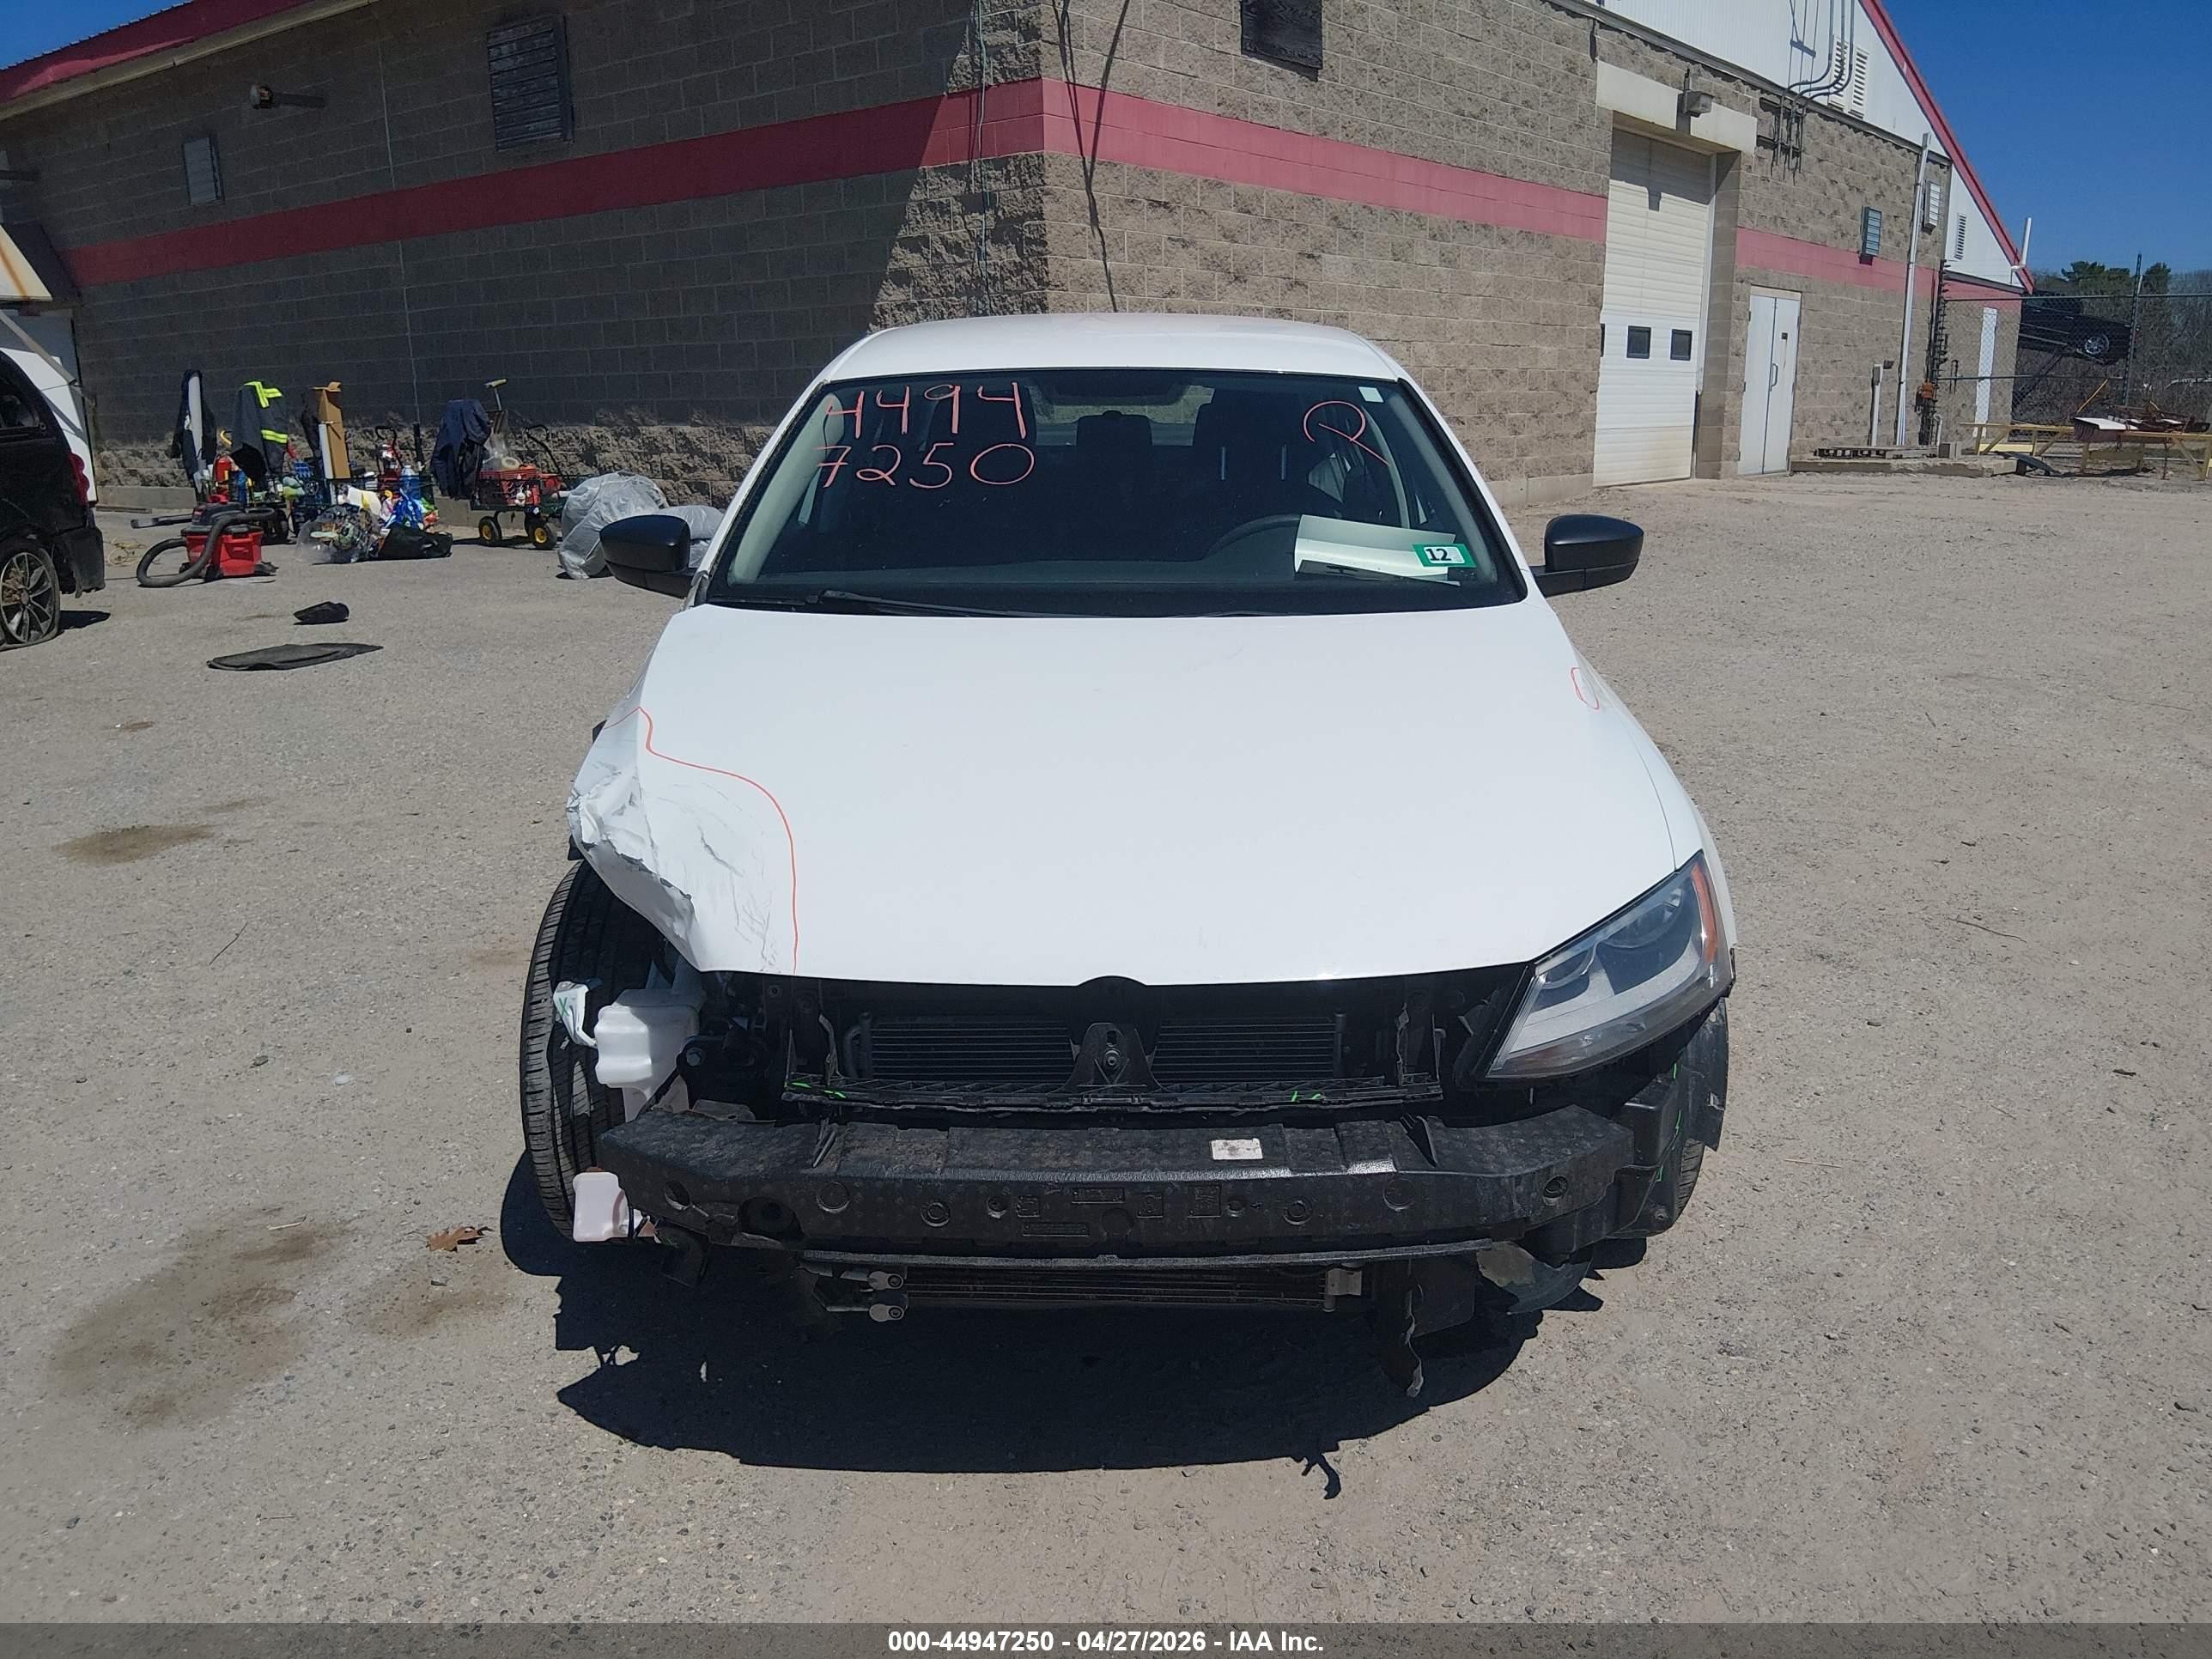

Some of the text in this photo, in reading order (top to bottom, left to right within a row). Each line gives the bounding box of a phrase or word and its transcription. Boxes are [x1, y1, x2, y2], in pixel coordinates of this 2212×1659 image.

[825, 382, 1027, 439] 4494
[816, 442, 1035, 489] 7250
[1425, 548, 1452, 562] 12
